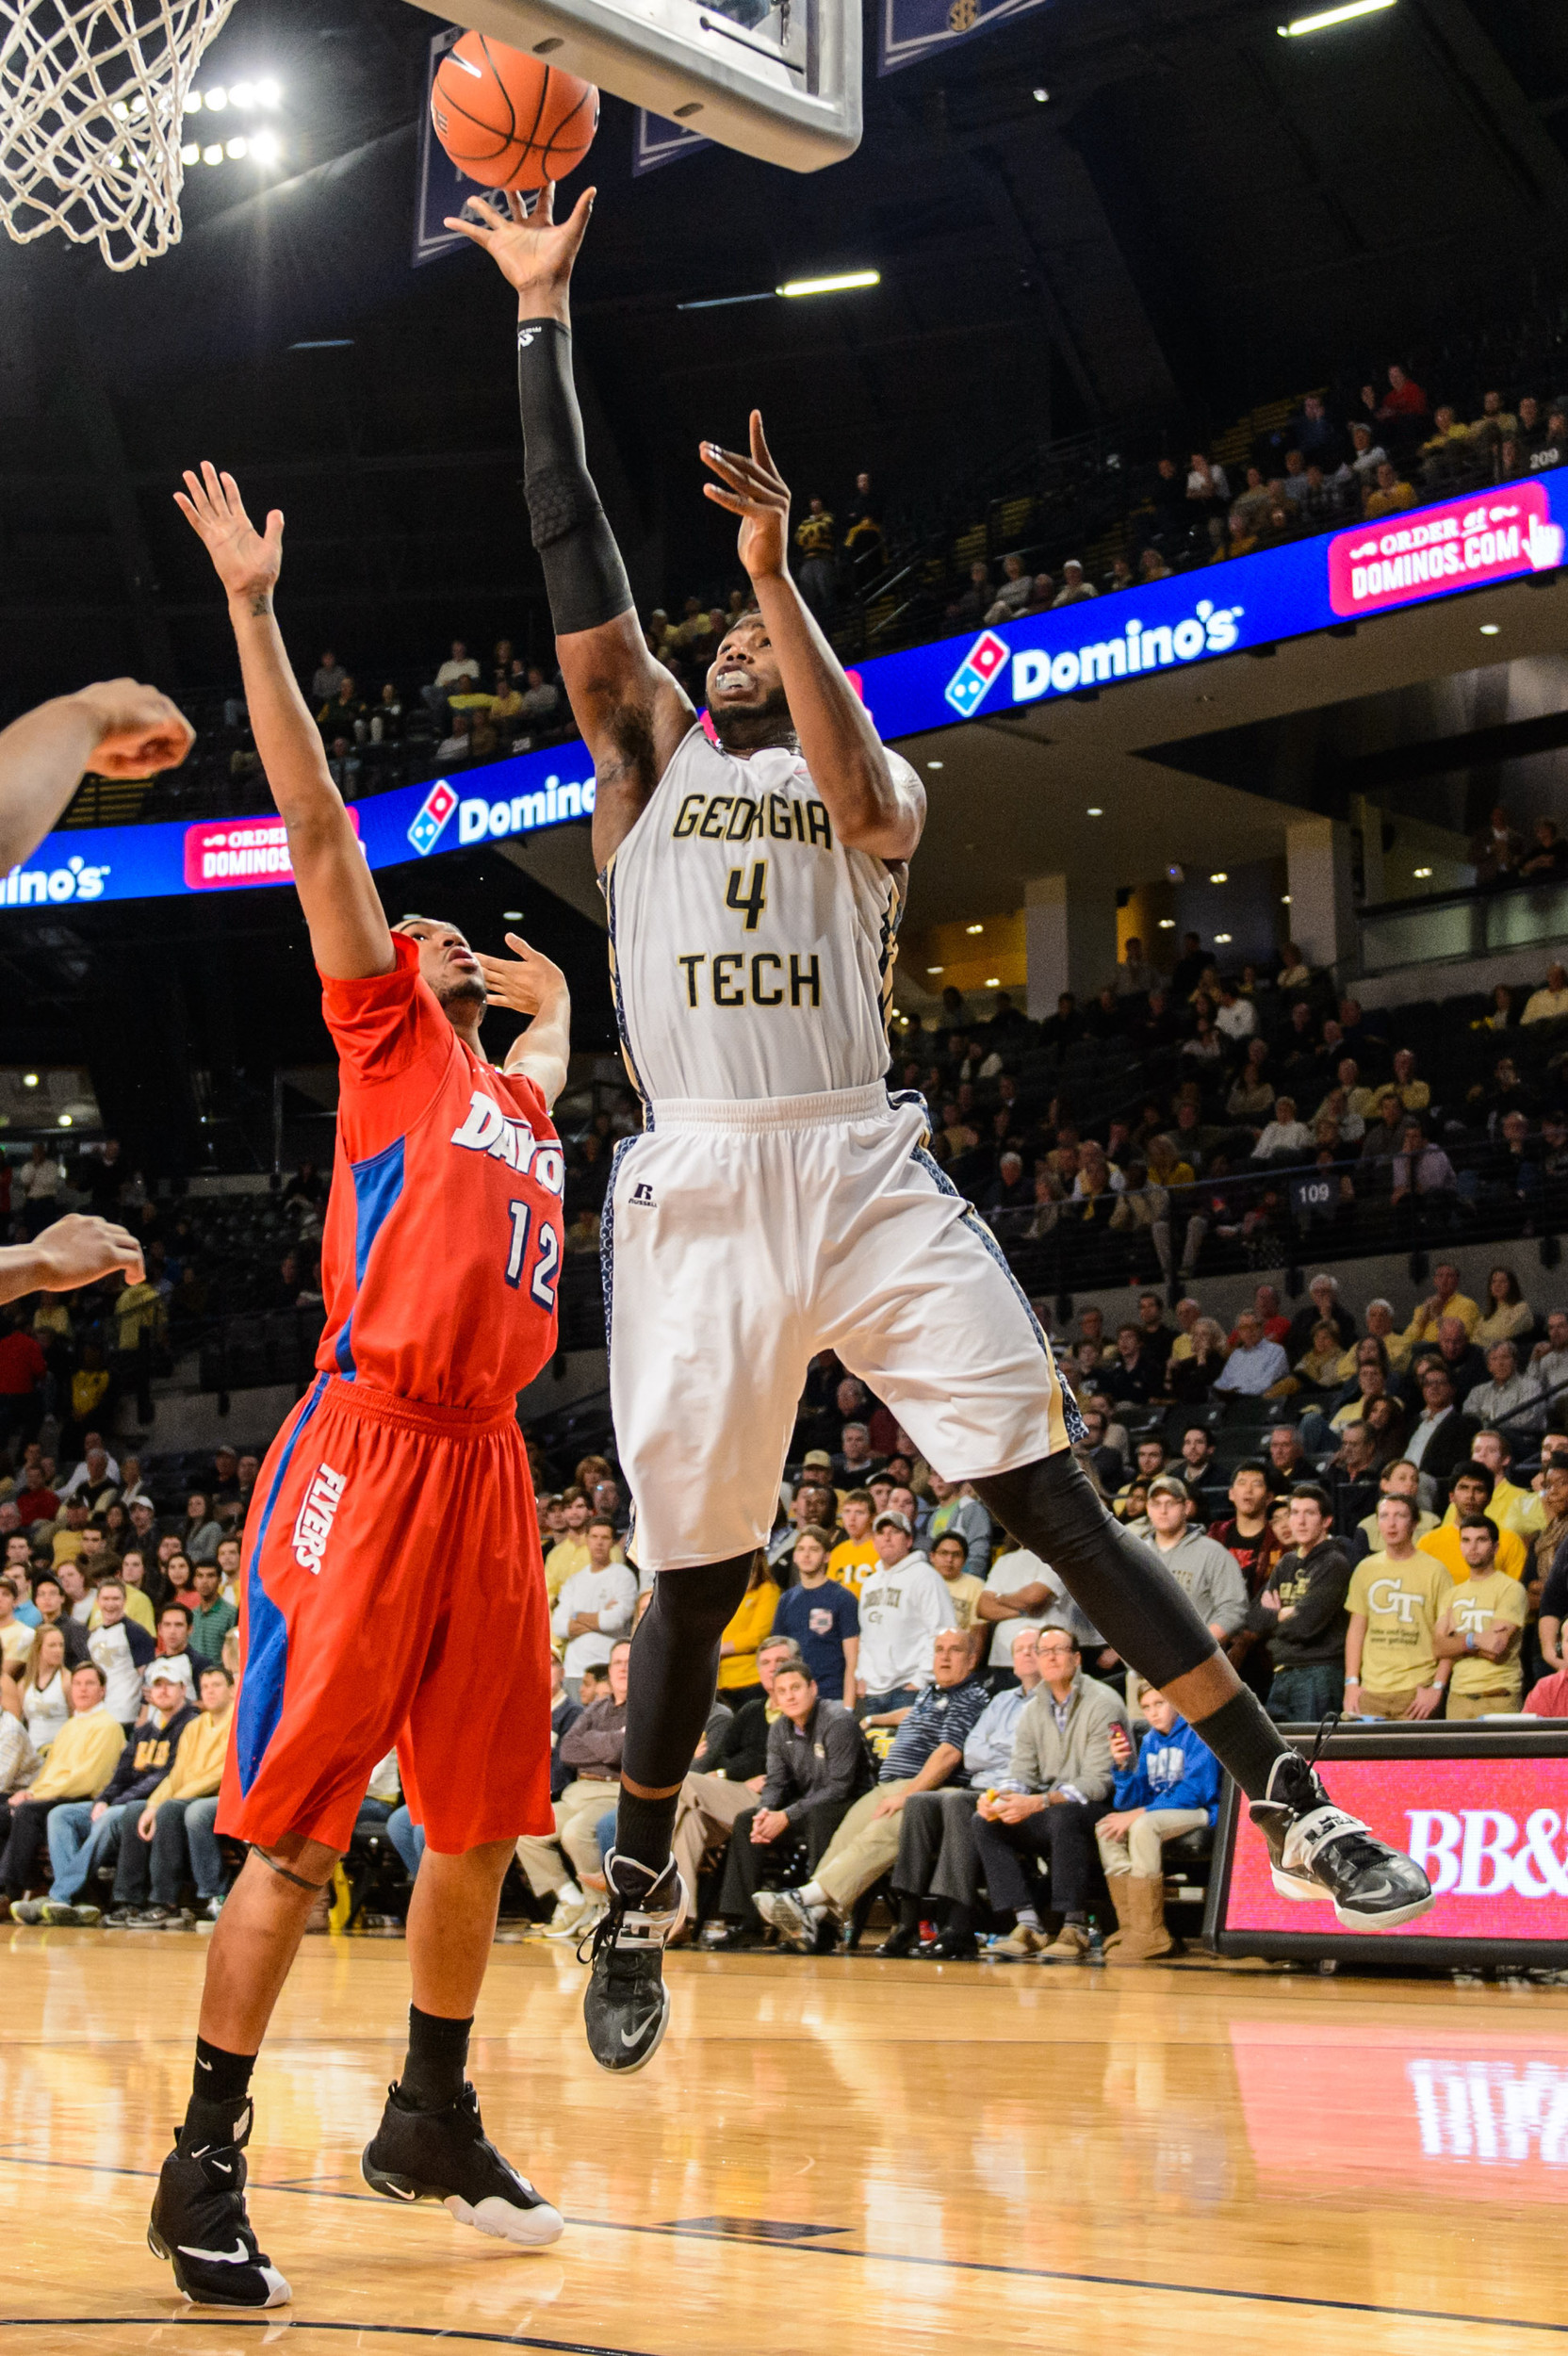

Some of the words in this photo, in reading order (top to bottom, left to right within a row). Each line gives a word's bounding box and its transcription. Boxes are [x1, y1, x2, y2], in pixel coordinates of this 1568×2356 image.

[1352, 525, 1519, 600] DOMINOS.COM
[1380, 517, 1461, 556] ORDER
[1012, 599, 1240, 702] Domino's
[671, 794, 833, 851] GEORGIA
[724, 859, 769, 933] 4
[677, 952, 824, 1009] TECH
[450, 1090, 564, 1203] DAYO
[629, 1198, 659, 1208] RUSSELL
[1299, 1183, 1330, 1203] 109
[504, 1199, 560, 1316] 12
[291, 1463, 348, 1576] FLYERS
[1368, 1578, 1425, 1623] GT
[1404, 1808, 1568, 1898] BB&
